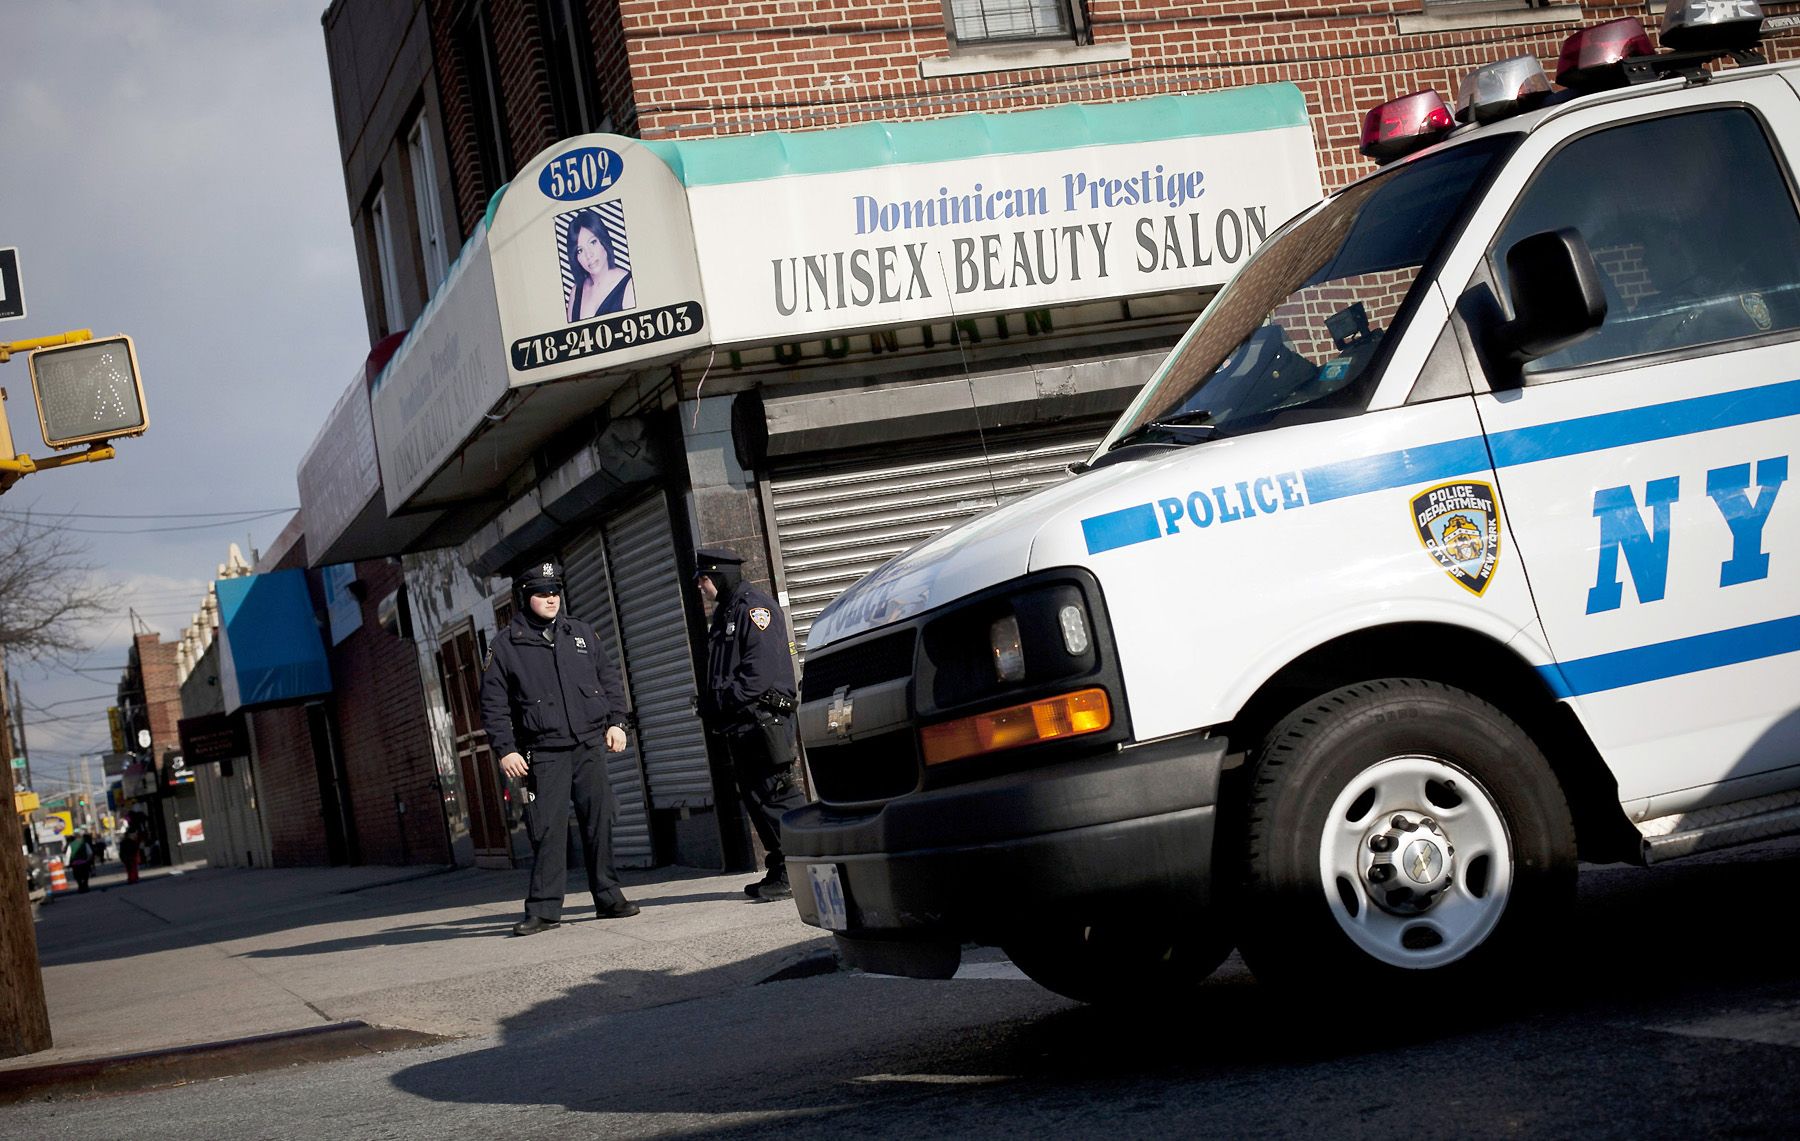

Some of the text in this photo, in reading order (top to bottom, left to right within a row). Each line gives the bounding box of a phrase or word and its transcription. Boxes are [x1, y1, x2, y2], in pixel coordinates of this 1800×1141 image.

[549, 149, 613, 198] 5502
[853, 165, 1206, 236] Dominican Prestige
[771, 205, 1268, 316] UNISEX BEAUTY SALON
[517, 306, 692, 368] 718-240-9503
[1158, 470, 1304, 535] POLICE
[1418, 498, 1492, 528] DEPARTMENT
[1429, 485, 1475, 505] POLICE
[1426, 538, 1466, 579] CITY OF
[1480, 518, 1497, 579] NEW YORK
